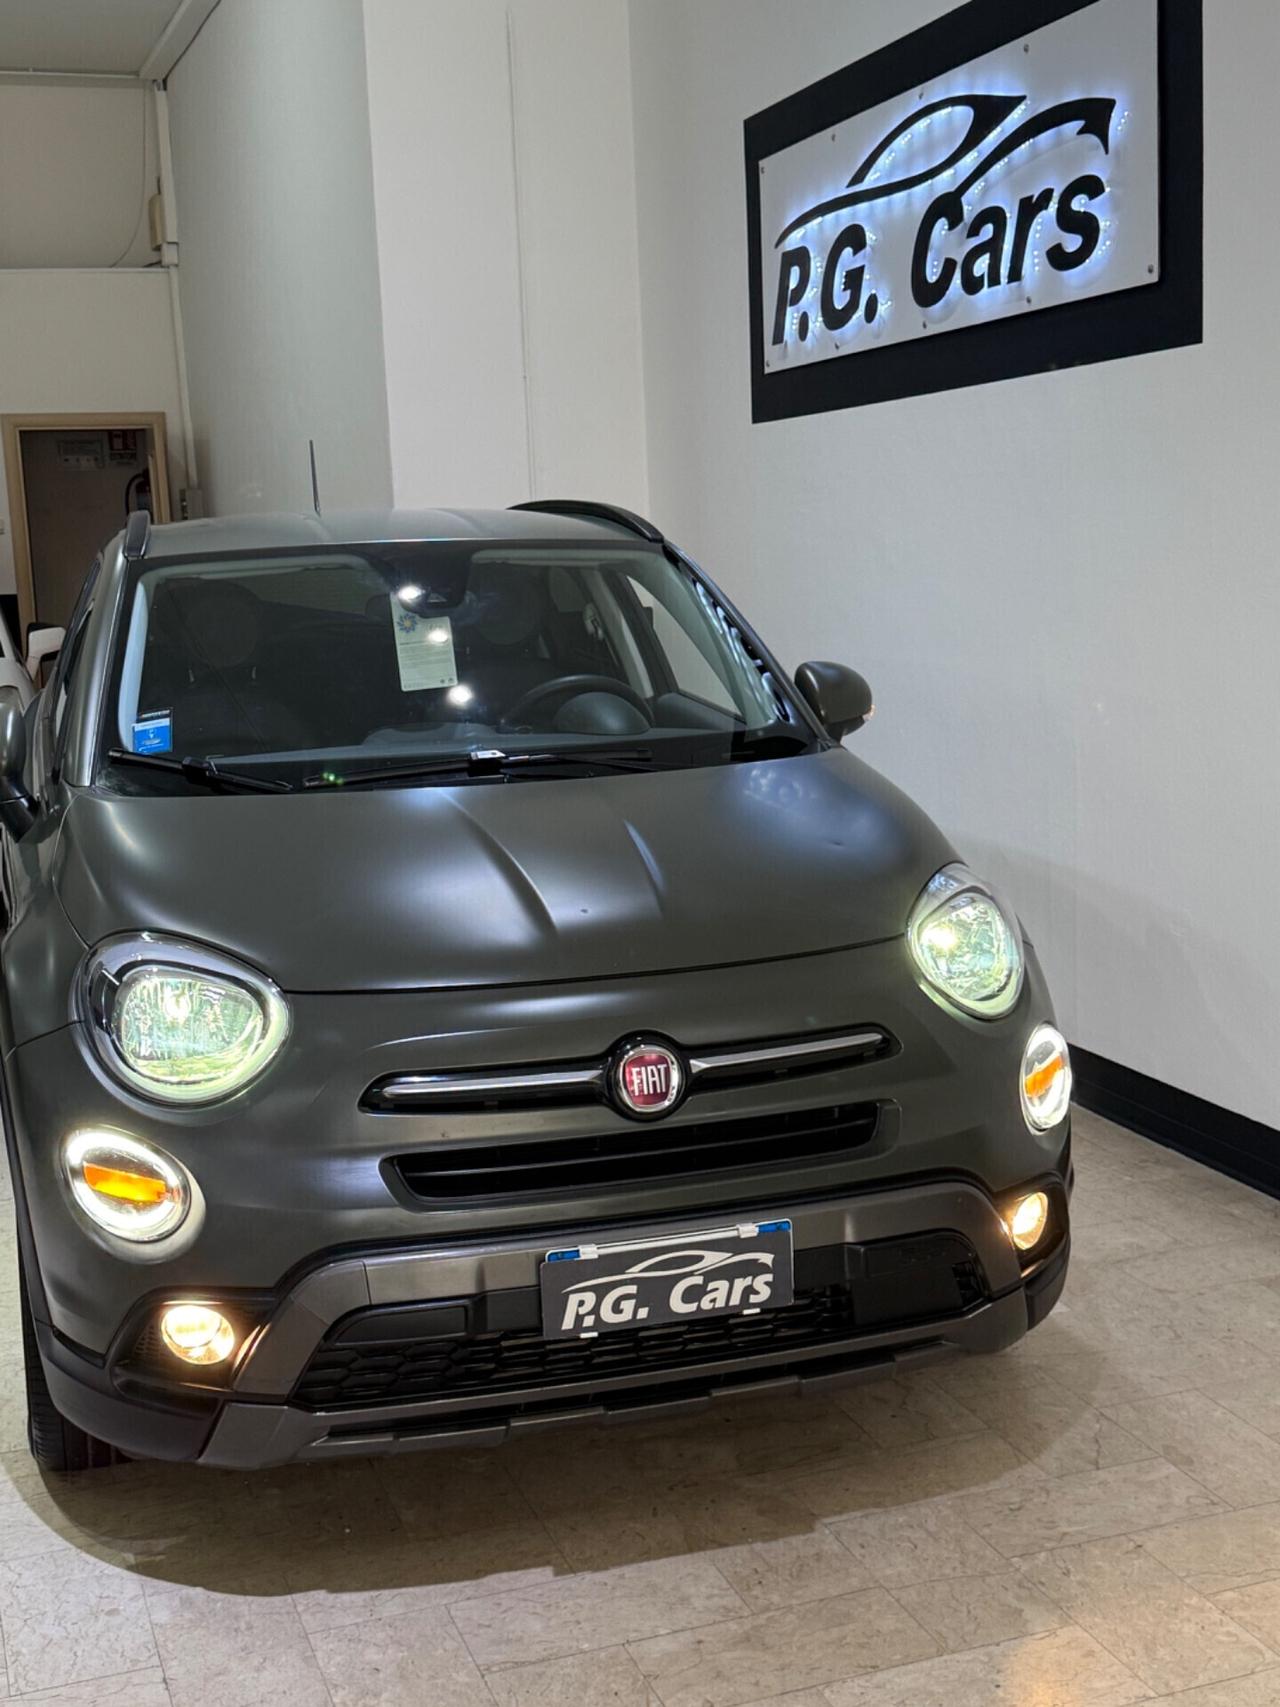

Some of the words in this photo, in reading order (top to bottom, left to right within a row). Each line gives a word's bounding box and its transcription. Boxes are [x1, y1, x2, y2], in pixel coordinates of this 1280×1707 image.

[772, 223, 878, 346] P.G.
[911, 174, 1105, 308] Cars
[631, 1064, 667, 1096] FIAT
[561, 1285, 649, 1330] P.G.
[669, 1273, 773, 1314] Cars
